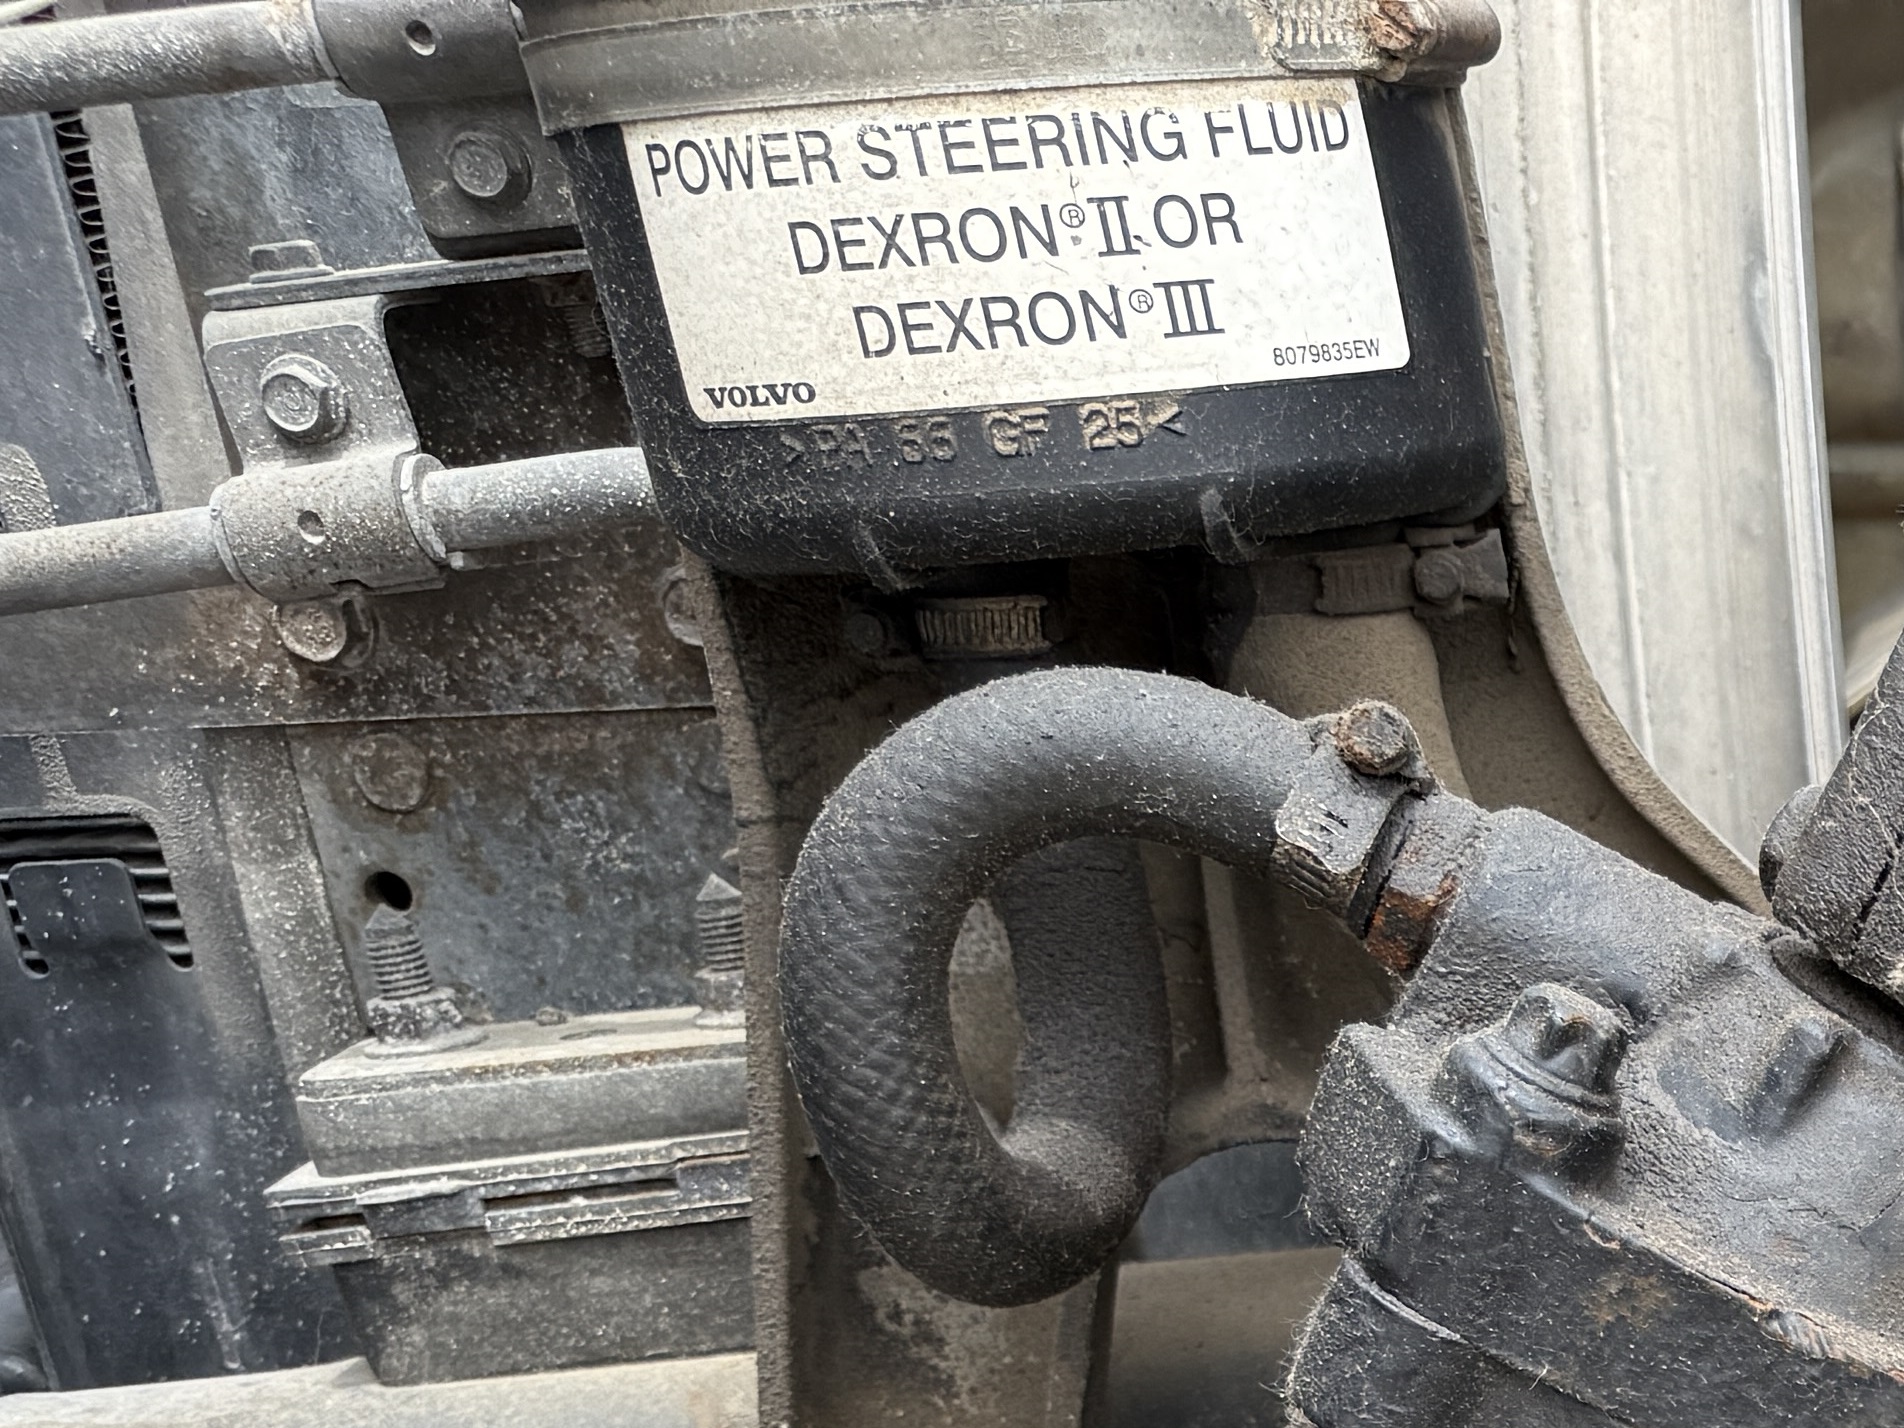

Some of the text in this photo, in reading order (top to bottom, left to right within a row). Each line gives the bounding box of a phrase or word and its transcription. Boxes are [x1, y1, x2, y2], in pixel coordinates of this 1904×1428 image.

[645, 100, 1350, 197] POWER STEERING FLUID
[1153, 192, 1244, 249] OR
[1273, 338, 1381, 367] 8079835EW
[704, 381, 817, 410] VOLVO
[983, 405, 1050, 458] GF
